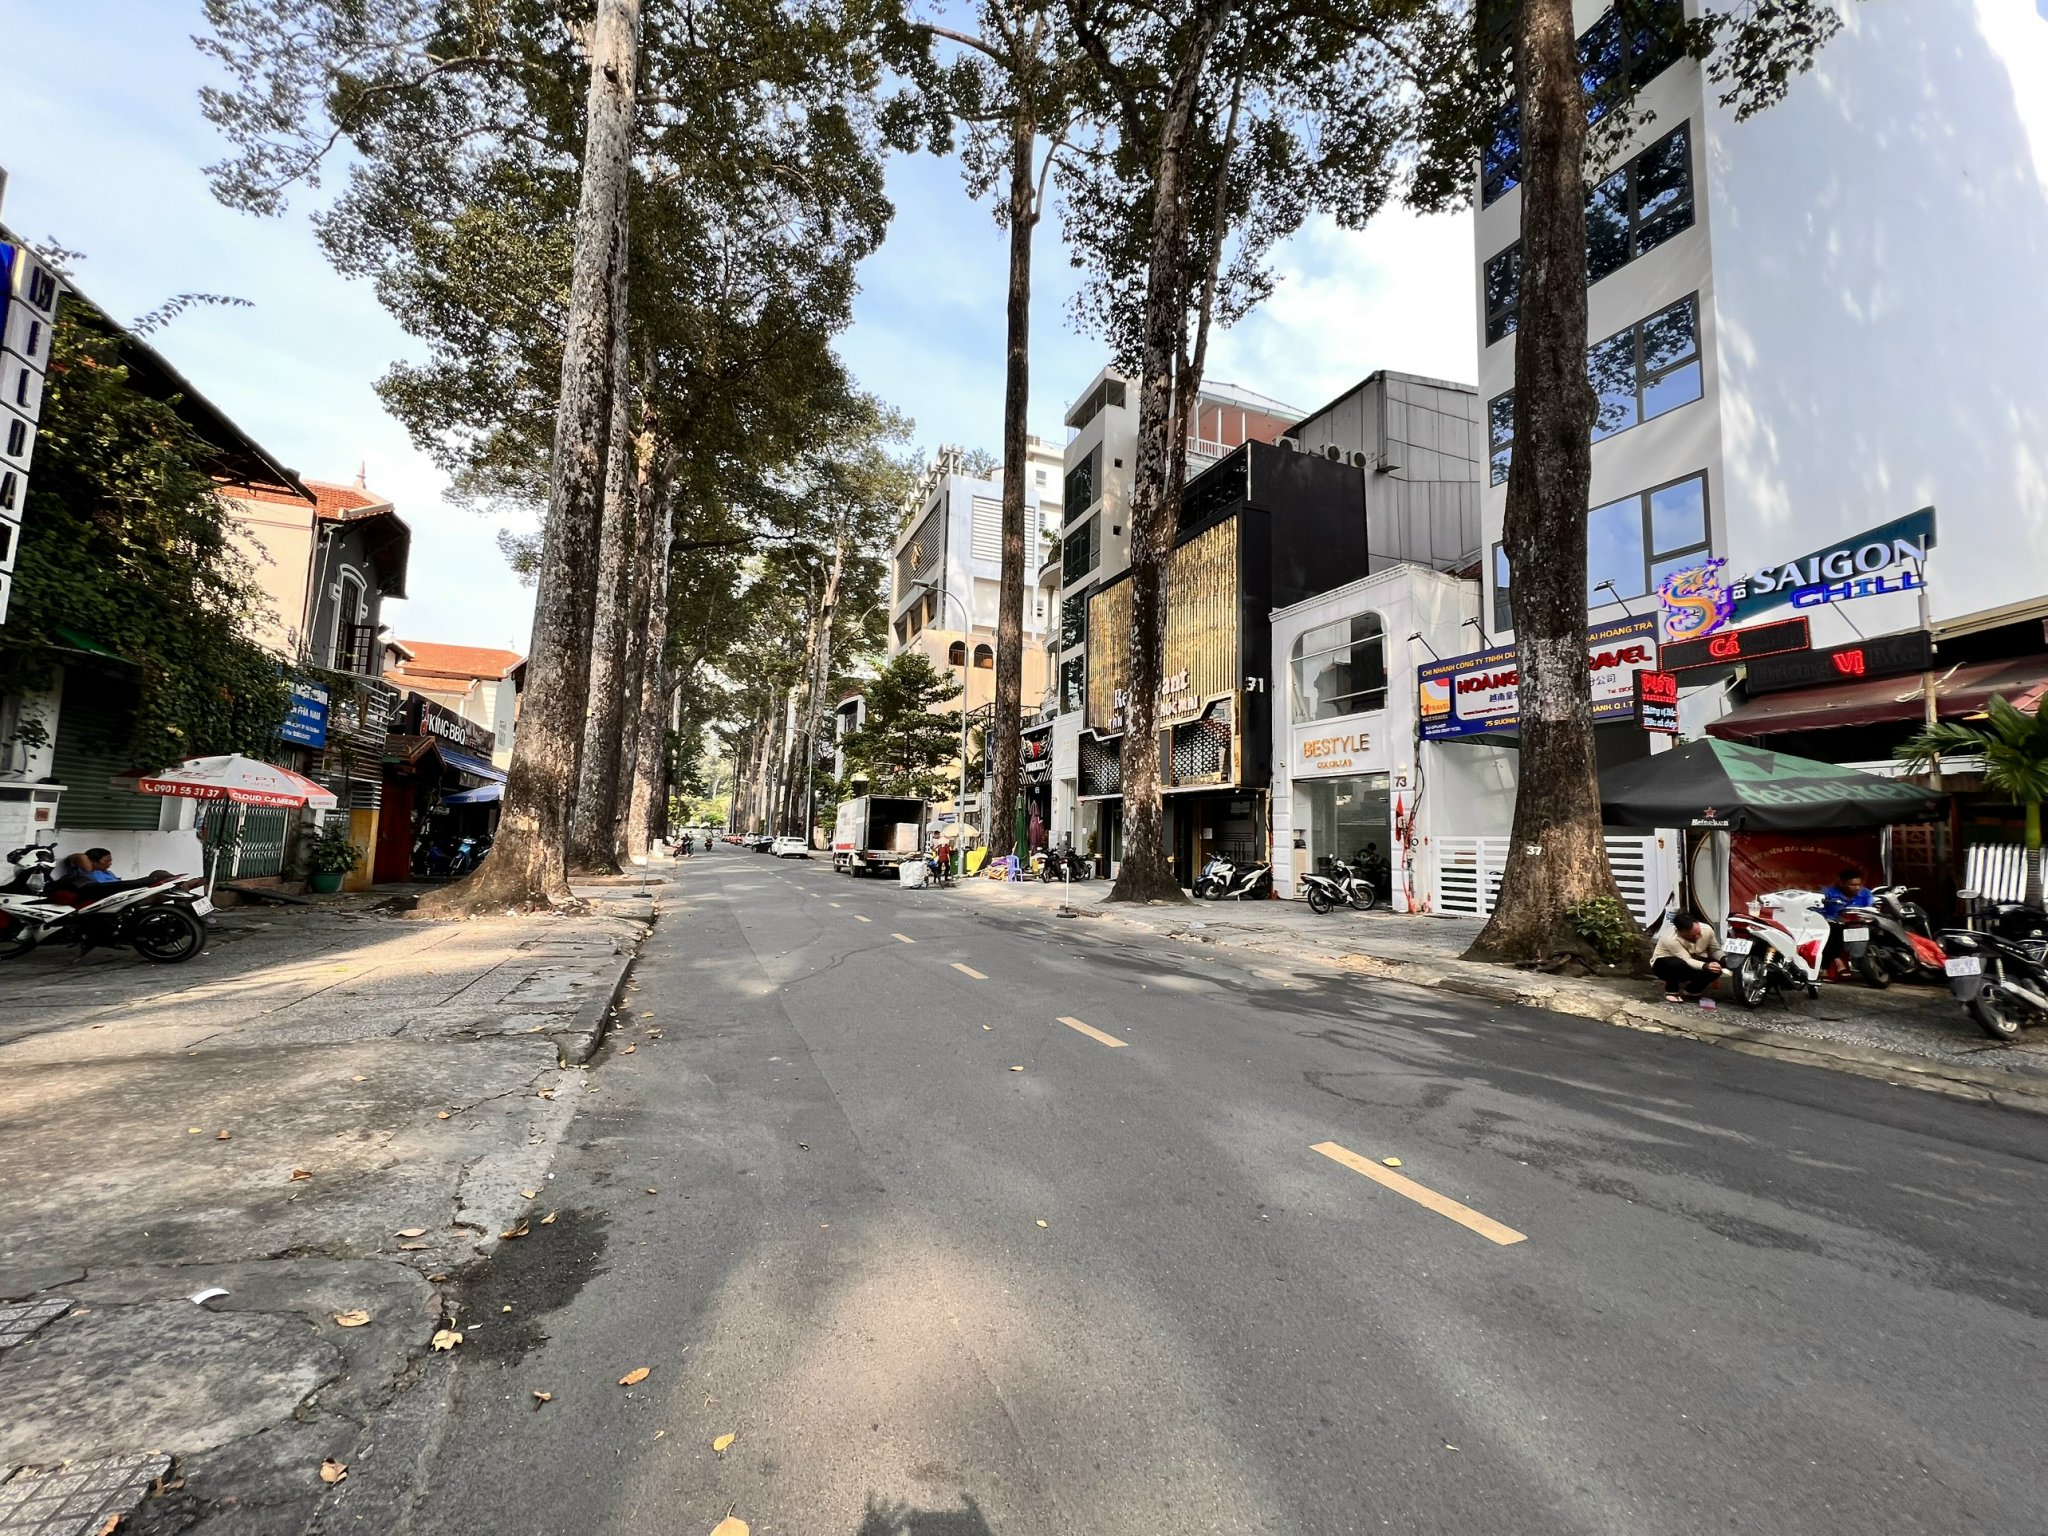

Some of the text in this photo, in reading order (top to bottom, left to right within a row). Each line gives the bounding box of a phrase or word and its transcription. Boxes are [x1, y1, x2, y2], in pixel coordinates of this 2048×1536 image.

[1753, 533, 1929, 595] SAIGON
[1733, 574, 1748, 599] BIA
[1790, 571, 1929, 609] CHILL
[1475, 657, 1483, 666] TY
[1485, 653, 1504, 664] TNHH
[1504, 651, 1516, 660] DU
[1633, 620, 1654, 632] TRÀ
[1708, 634, 1741, 657] Cá
[1457, 670, 1520, 695] HOÀNG
[1587, 645, 1653, 671] RAVEL
[1832, 650, 1866, 676] Vị
[428, 713, 449, 738] KING
[449, 723, 466, 746] BBQ
[1303, 733, 1370, 758] BESTYLE
[155, 783, 220, 798] 0901 55 31 37
[1394, 775, 1407, 787] 73
[232, 792, 262, 802] CLOUD
[264, 795, 299, 807] CAMERA
[1691, 818, 1729, 827] Heineken
[1526, 845, 1543, 856] 37
